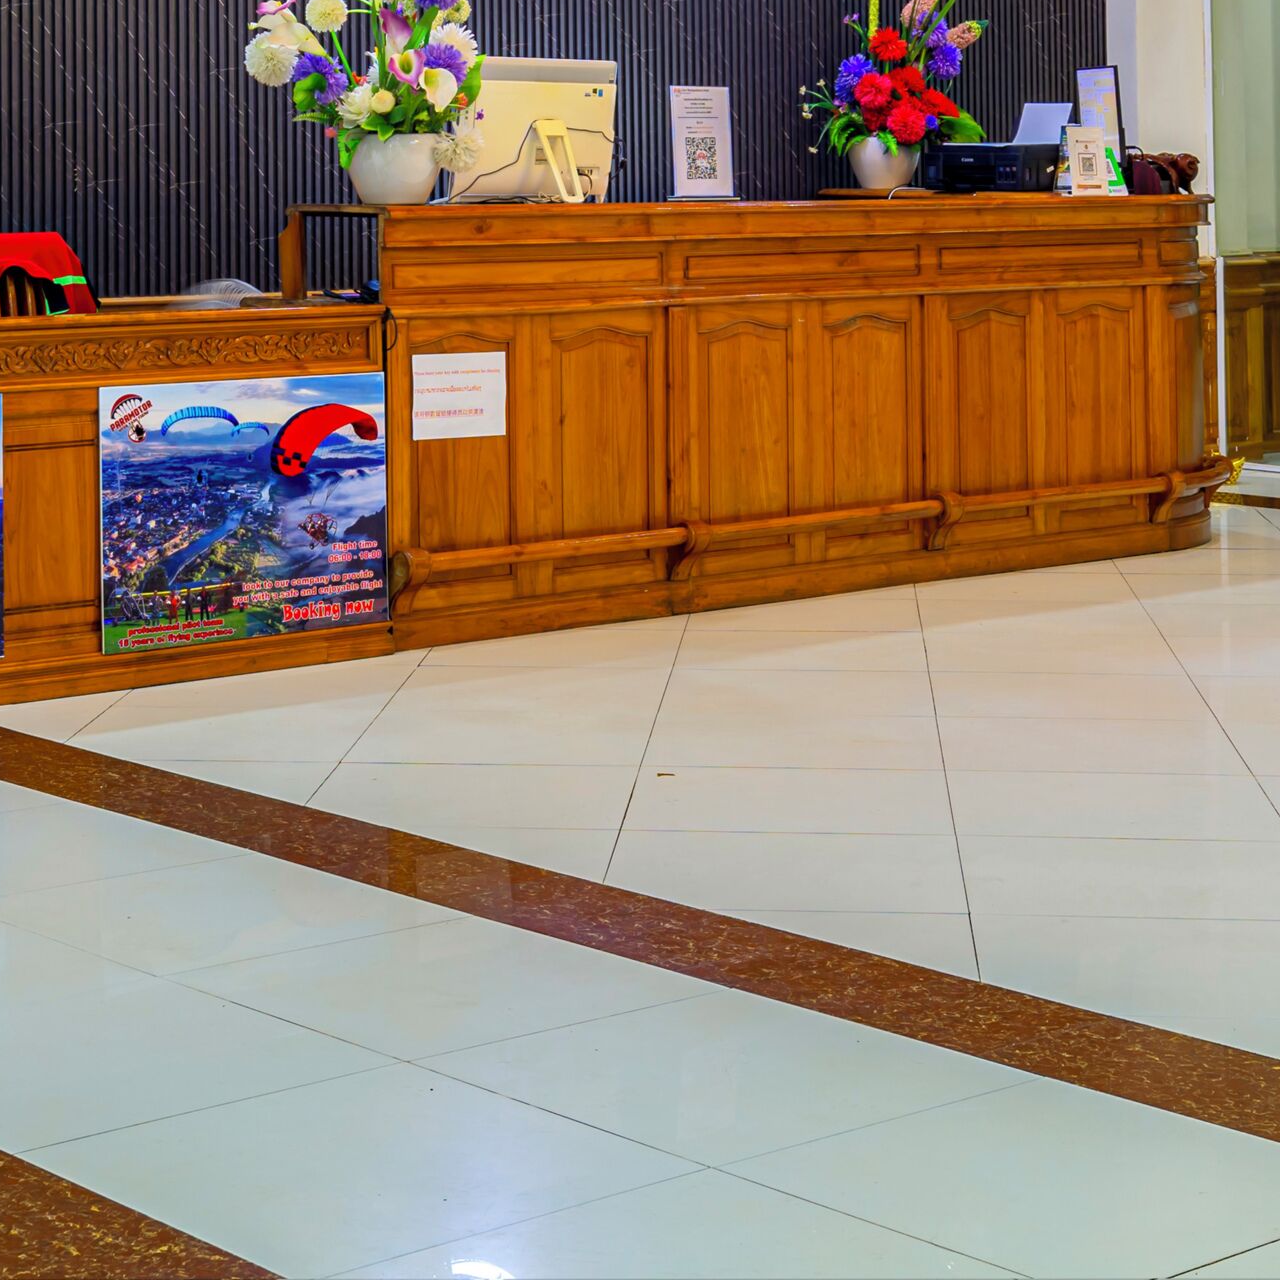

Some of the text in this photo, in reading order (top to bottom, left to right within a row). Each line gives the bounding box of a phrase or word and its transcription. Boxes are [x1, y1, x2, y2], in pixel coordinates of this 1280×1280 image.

[110, 400, 152, 432] PARAMOTOR
[328, 553, 352, 563] 06:00
[359, 550, 382, 560] 18:00
[332, 540, 378, 552] Flight time
[263, 580, 273, 589] to
[274, 580, 290, 588] our
[291, 574, 330, 586] company
[332, 573, 340, 582] to
[342, 569, 374, 582] provide
[232, 596, 249, 606] you
[251, 590, 270, 602] with
[280, 588, 299, 598] safe
[300, 586, 317, 596] and
[318, 582, 360, 595] enjoyable
[360, 580, 383, 591] flight
[282, 599, 375, 622] Booking now
